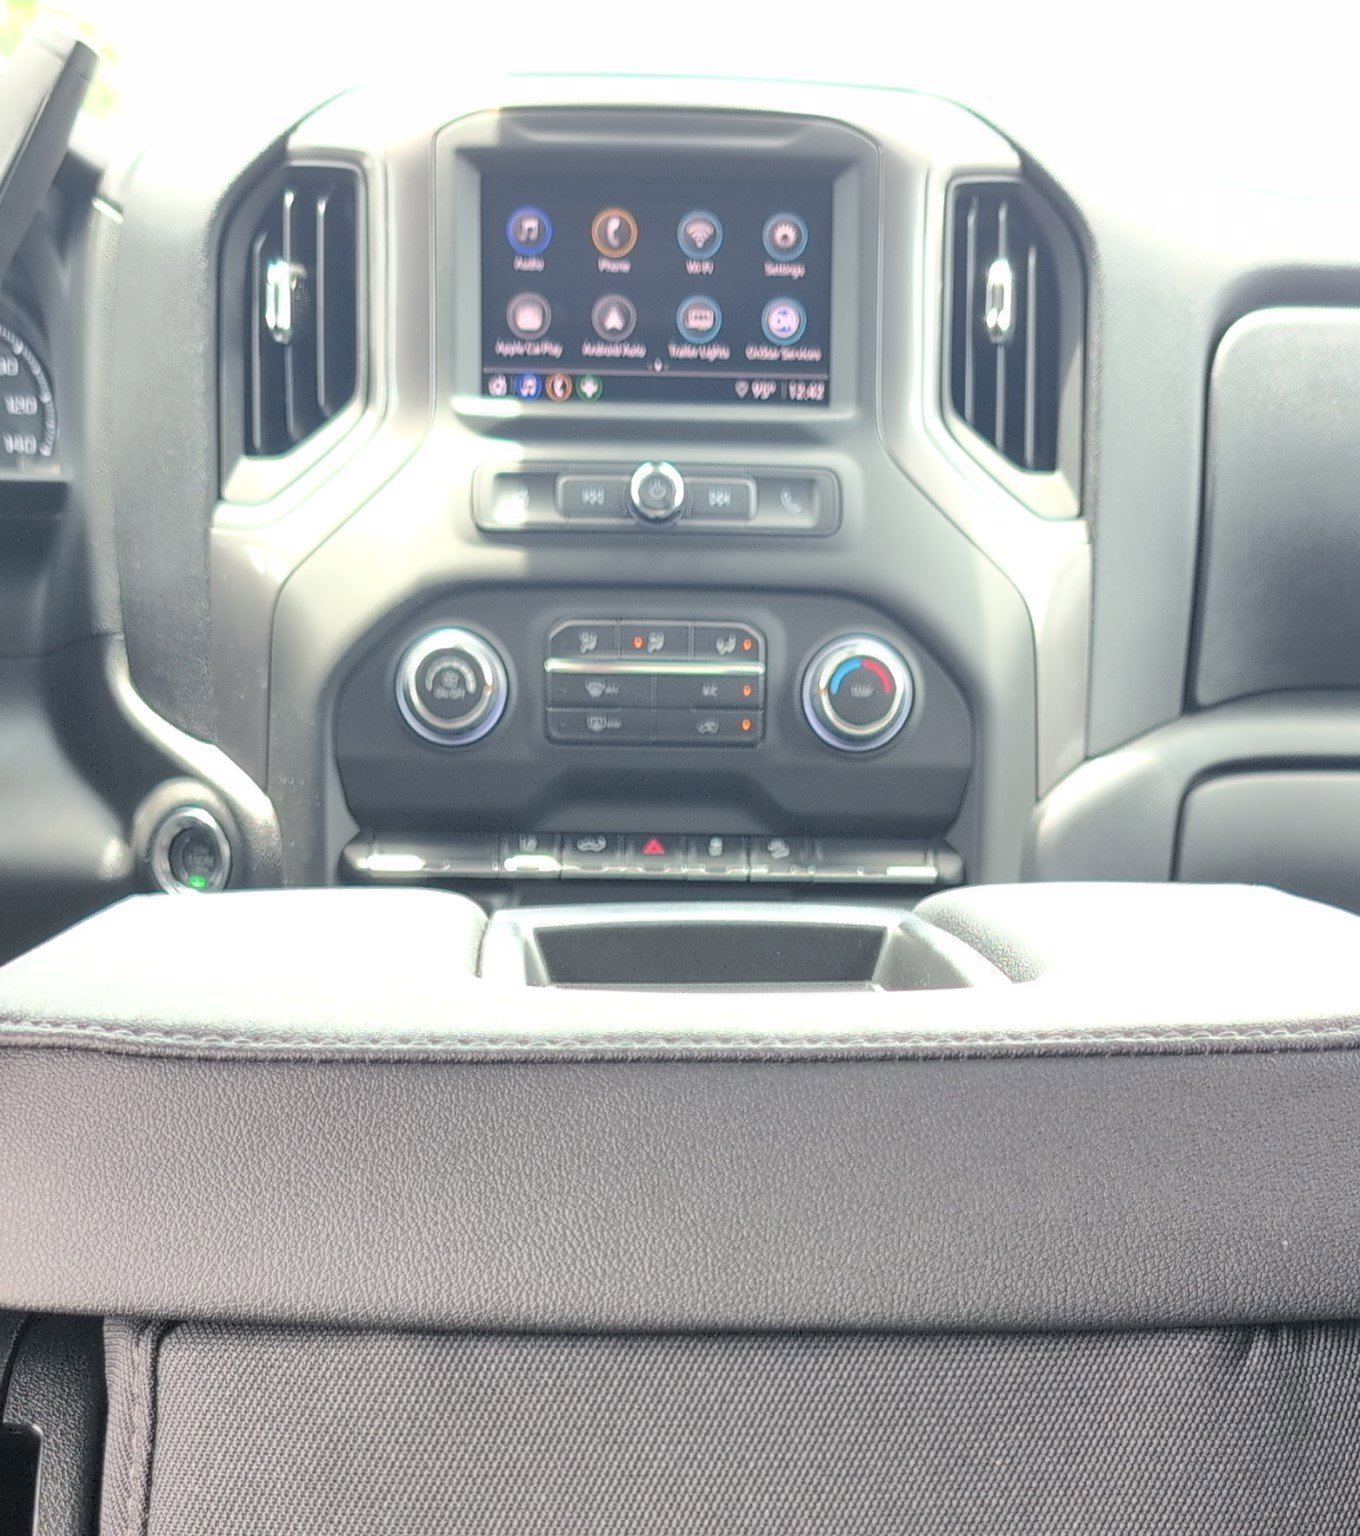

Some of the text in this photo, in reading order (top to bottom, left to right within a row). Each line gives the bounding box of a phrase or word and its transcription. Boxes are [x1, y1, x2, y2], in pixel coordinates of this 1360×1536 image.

[597, 257, 631, 273] Phone
[764, 262, 805, 279] Settings
[495, 338, 525, 357] Apple
[581, 339, 622, 358] Android
[5, 395, 38, 415] 120
[3, 434, 37, 454] 140
